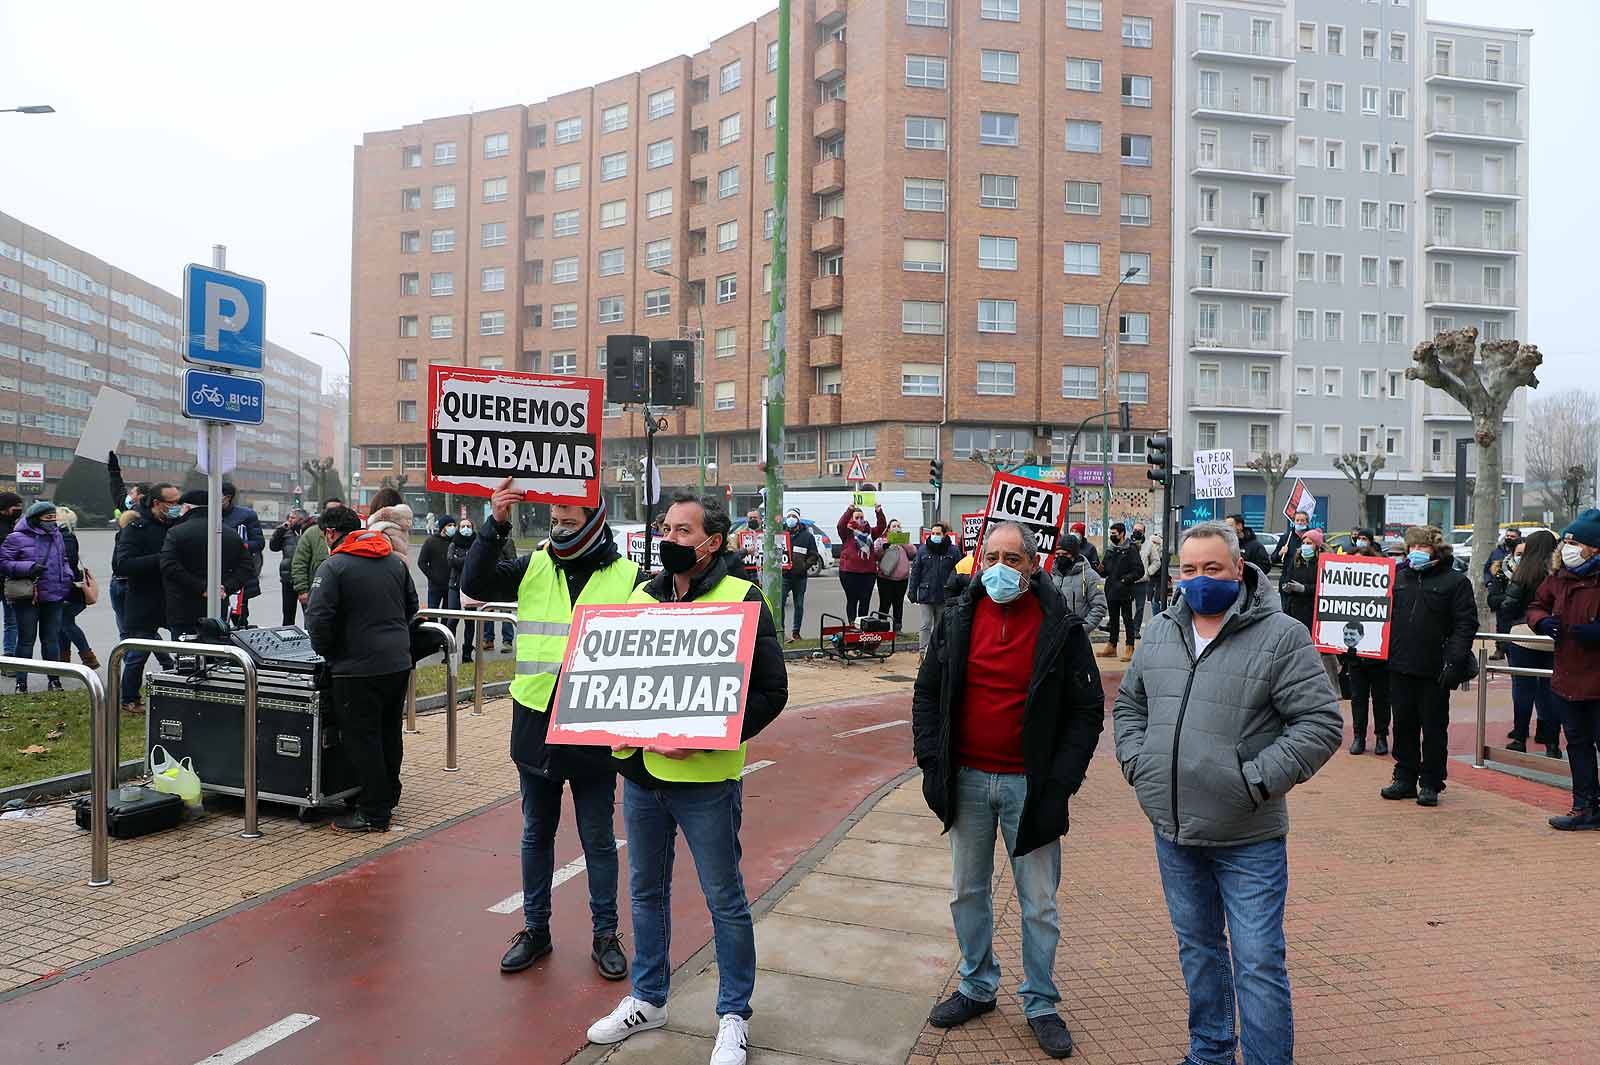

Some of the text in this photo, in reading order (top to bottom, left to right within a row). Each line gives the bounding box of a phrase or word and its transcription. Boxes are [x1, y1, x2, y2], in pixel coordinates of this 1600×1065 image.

[204, 281, 250, 352] P
[230, 393, 259, 407] BICIS
[443, 391, 586, 429] QUEREMOS
[437, 432, 595, 477] TRABAJAR
[1209, 451, 1231, 462] PEOR
[1209, 478, 1221, 487] LOS
[996, 484, 1053, 523] IGEA
[1320, 566, 1390, 589] MAÑUECO
[1318, 599, 1388, 619] DIMISIÓN
[583, 628, 737, 662] QUEREMOS
[567, 674, 741, 713] TRABAJAR
